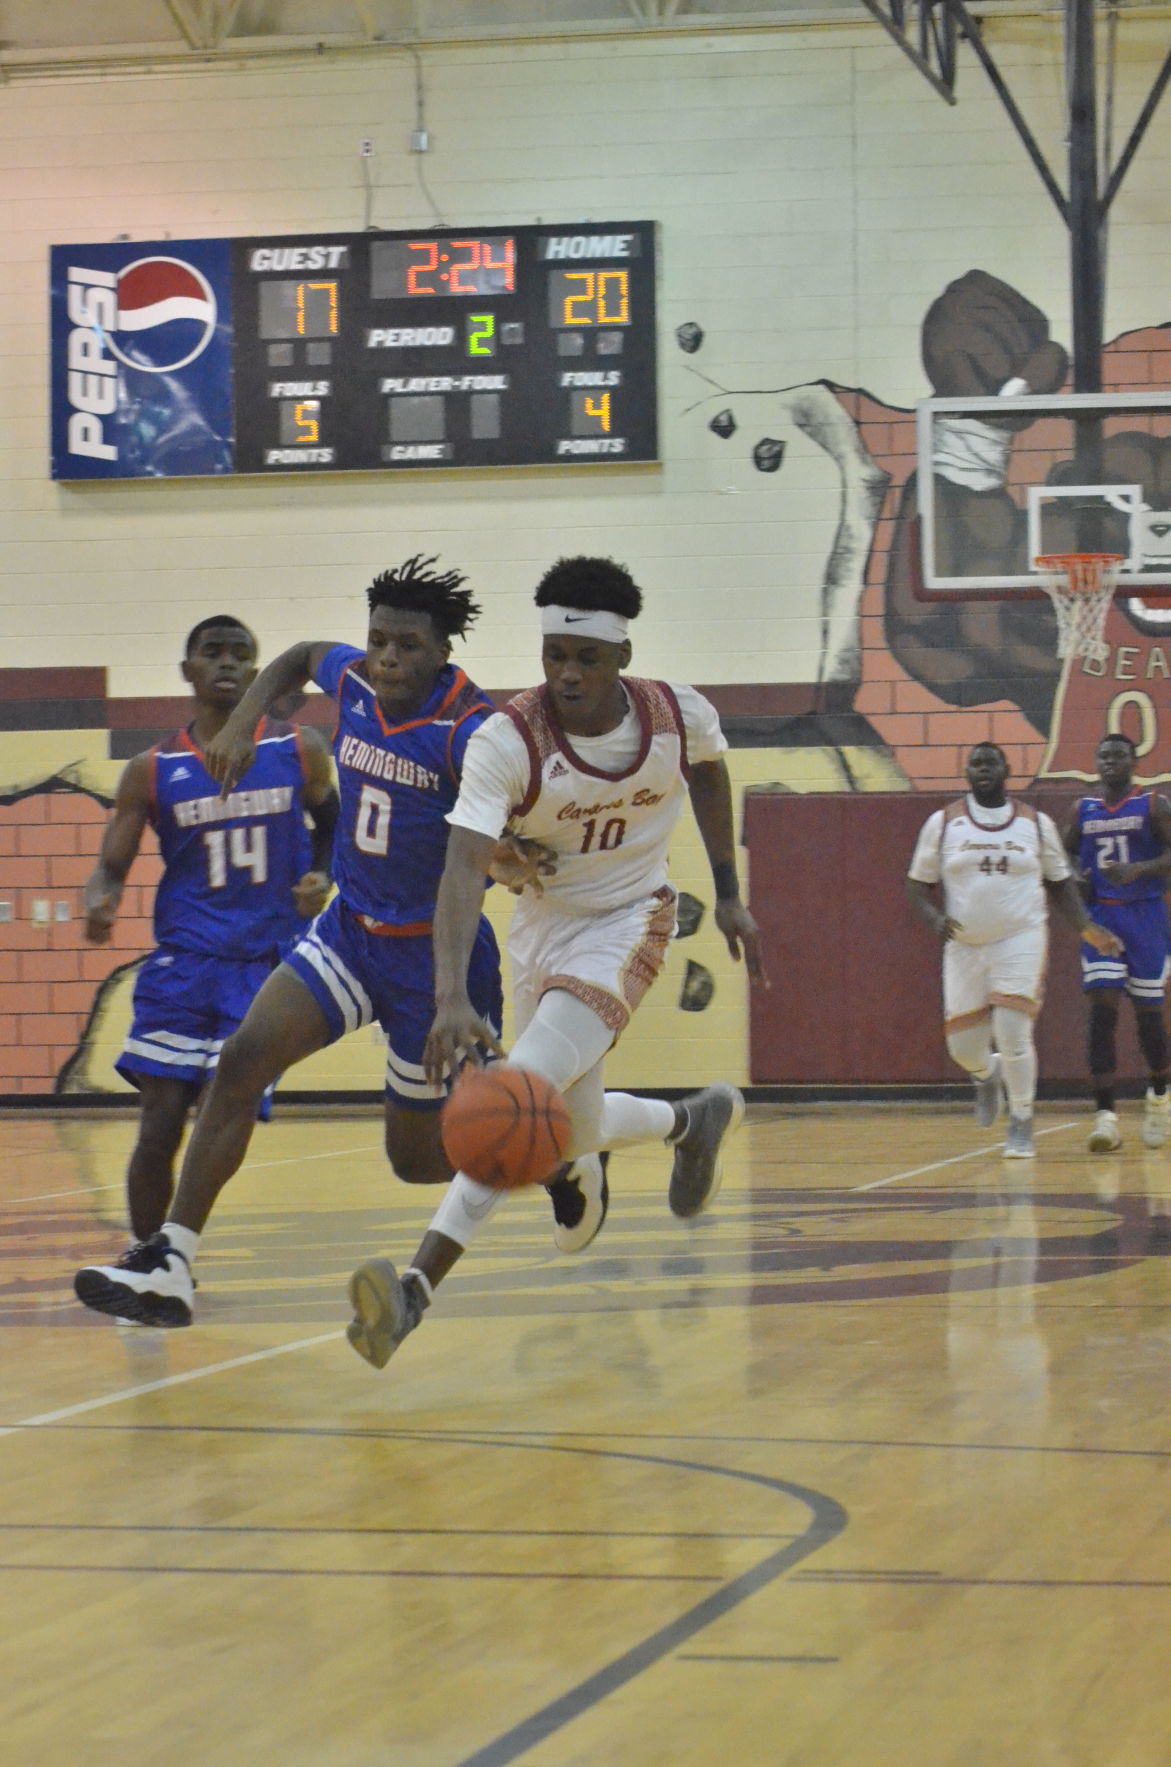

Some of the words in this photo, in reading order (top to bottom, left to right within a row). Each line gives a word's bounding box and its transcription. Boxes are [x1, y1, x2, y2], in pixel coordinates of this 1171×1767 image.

[250, 246, 348, 271] GUEST
[545, 235, 634, 260] HOME
[406, 239, 515, 294] 2:24
[295, 282, 339, 334] 17
[563, 271, 630, 325] 20
[367, 327, 455, 348] PERIOD
[468, 315, 495, 355] 2
[67, 266, 119, 461] PEPSI
[560, 370, 621, 387] FOULS
[270, 381, 331, 397] FOULS
[294, 403, 319, 442] 5
[583, 393, 611, 432] 4
[266, 448, 334, 464] POINTS
[389, 444, 446, 460] GAME
[556, 438, 626, 455] POINTS
[356, 784, 392, 856] 0
[580, 817, 627, 854] 10
[204, 825, 268, 888] 14
[978, 855, 1009, 876] 44
[1095, 834, 1130, 869] 21
